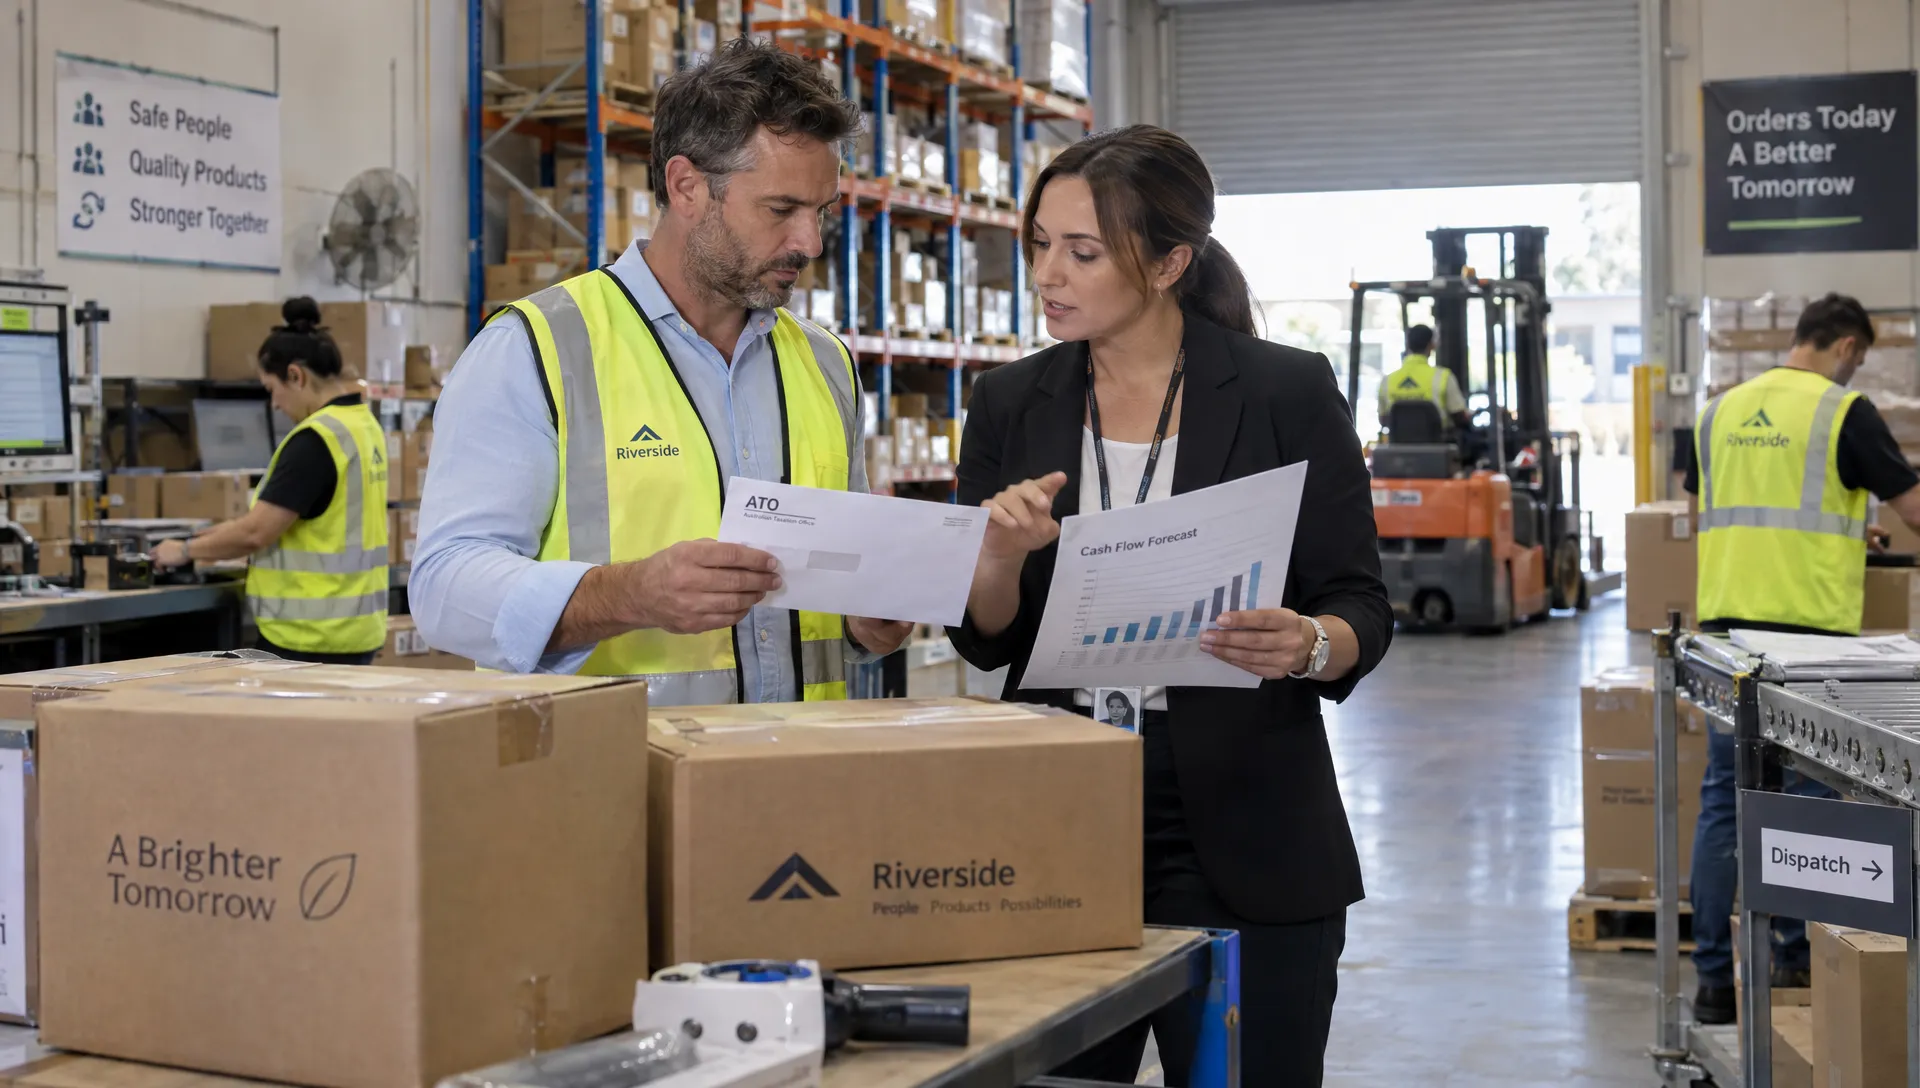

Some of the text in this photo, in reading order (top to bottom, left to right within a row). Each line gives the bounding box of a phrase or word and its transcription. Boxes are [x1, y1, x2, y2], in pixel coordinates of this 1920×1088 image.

[129, 99, 232, 142] Safe People
[1726, 103, 1897, 134] Orders Today
[1726, 140, 1837, 167] A Better
[129, 149, 267, 192] Quality Products
[1726, 175, 1856, 200] Tomorrow
[129, 197, 269, 237] Stronger Together
[616, 444, 680, 460] Riverside
[1726, 432, 1791, 449] Riverside
[745, 495, 780, 512] ATO
[1080, 528, 1198, 556] Cash Flow Forecast
[107, 833, 282, 883] A Brighter
[1771, 846, 1851, 875] Dispatch
[873, 859, 1015, 890] Riverside
[107, 872, 276, 922] Tomorrow
[930, 900, 991, 914] Products
[1000, 895, 1082, 912] Possibilities
